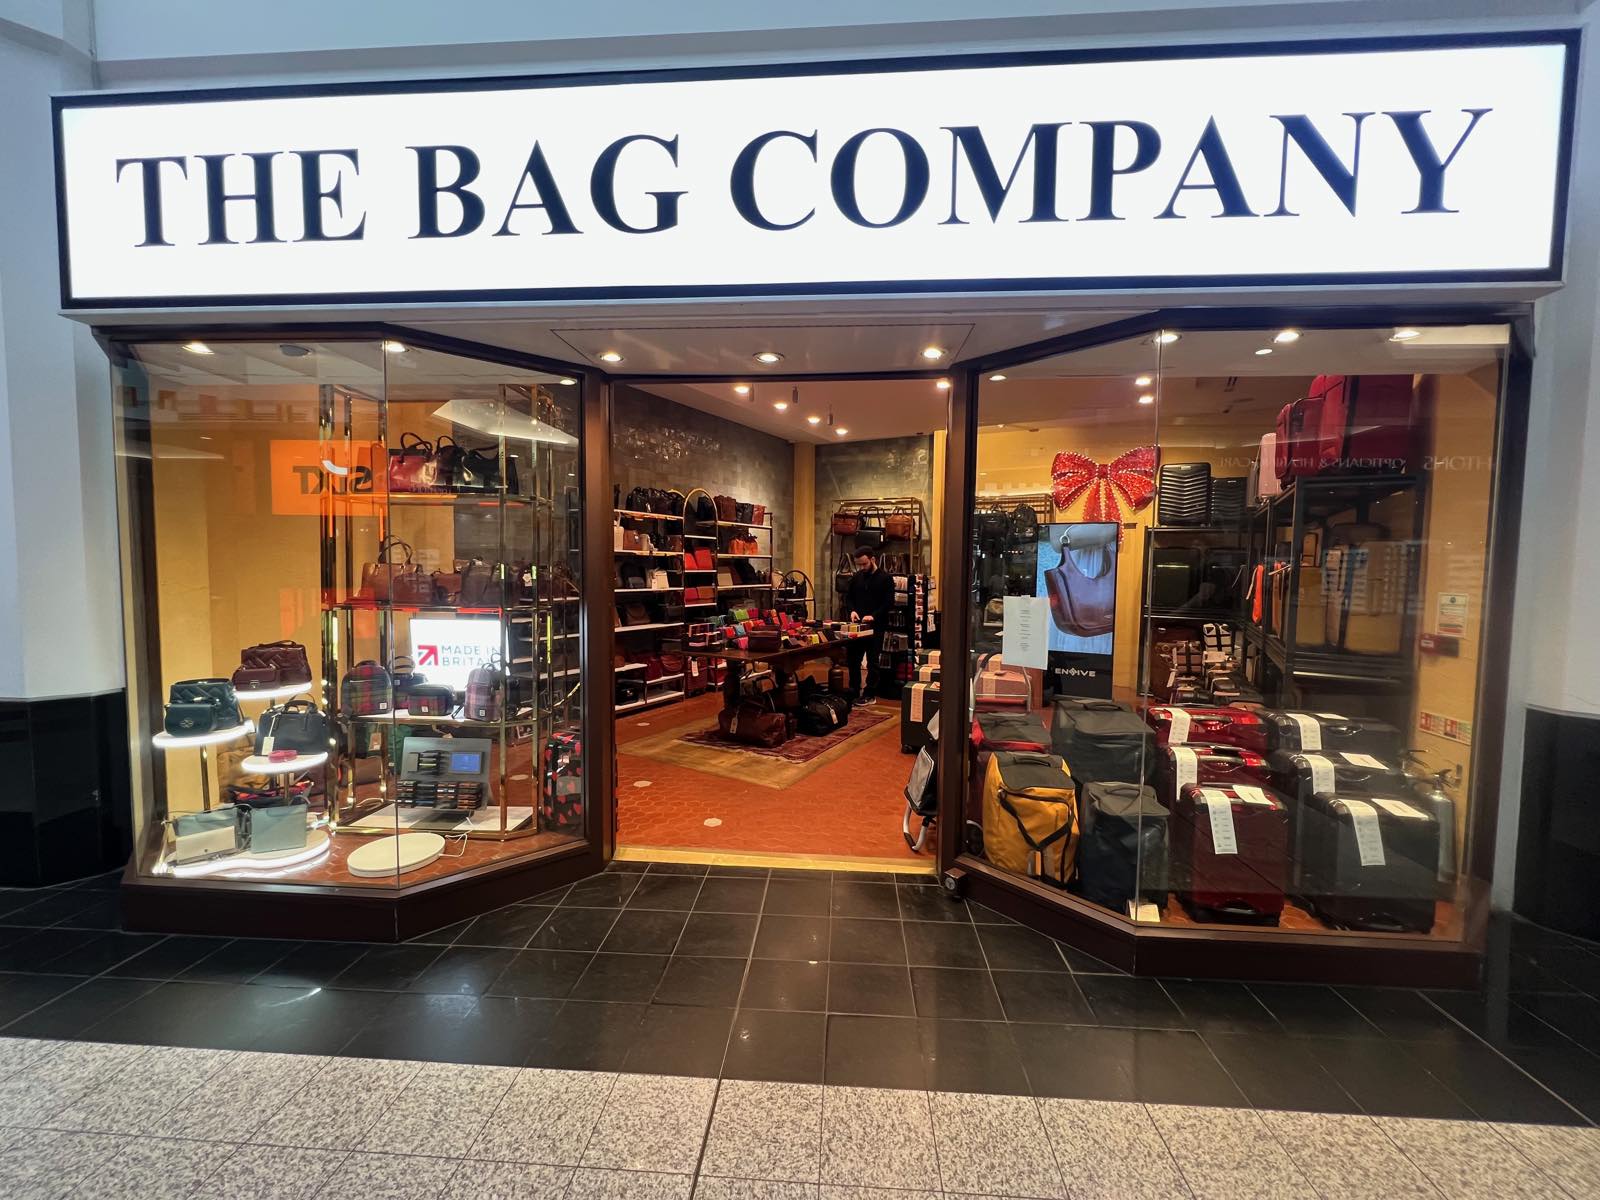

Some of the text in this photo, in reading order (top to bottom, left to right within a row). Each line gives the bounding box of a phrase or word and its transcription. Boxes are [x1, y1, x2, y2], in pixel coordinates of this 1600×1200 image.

[116, 108, 1493, 248] THE BAG COMPANY
[441, 645, 481, 655] MADE
